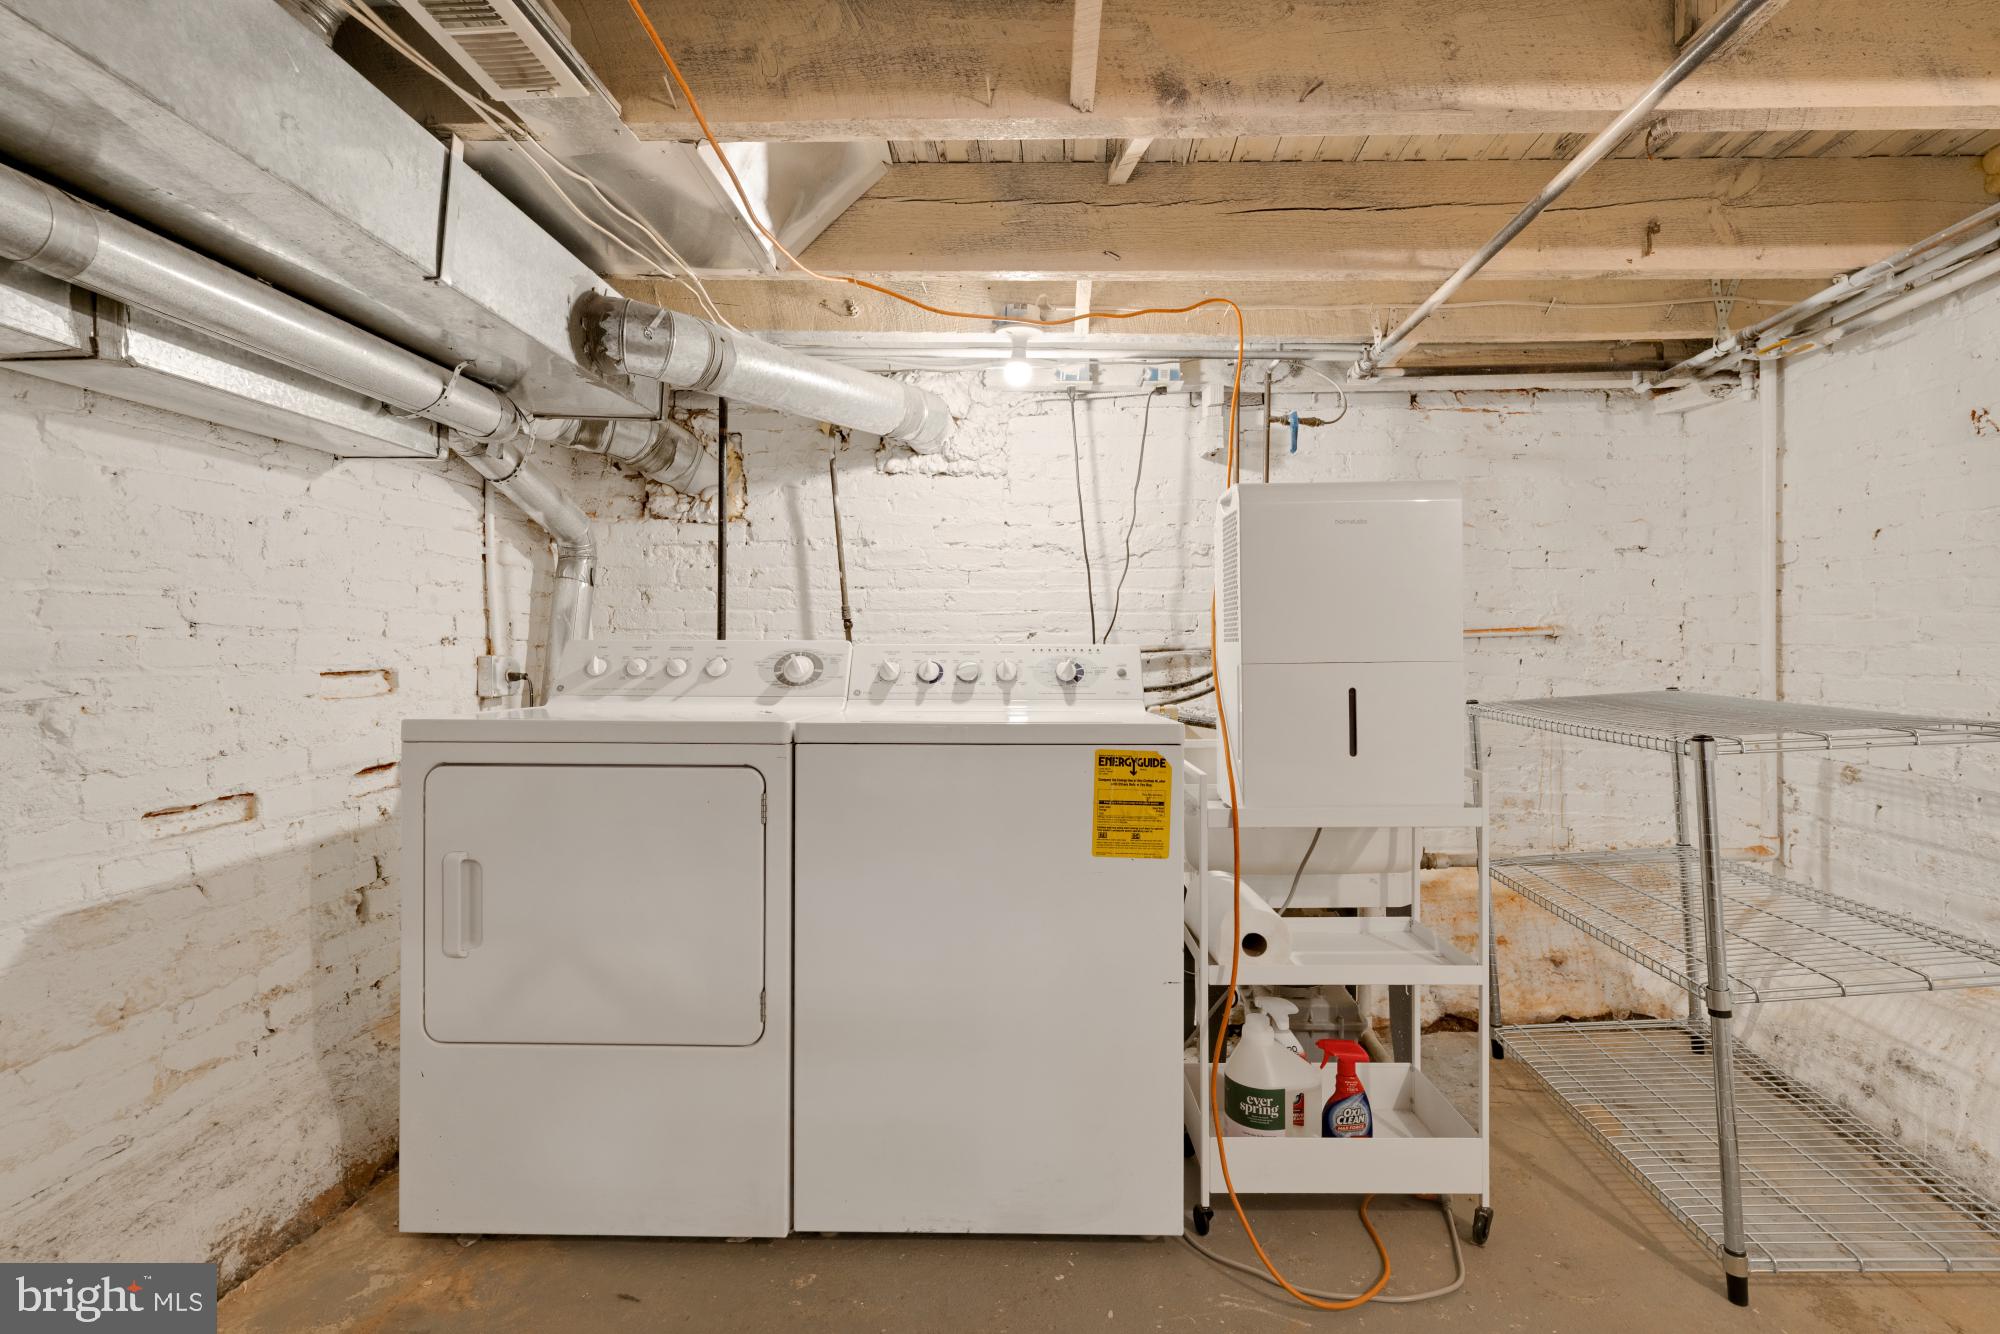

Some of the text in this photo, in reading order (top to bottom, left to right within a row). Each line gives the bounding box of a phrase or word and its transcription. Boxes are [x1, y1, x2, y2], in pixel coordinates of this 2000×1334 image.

[1099, 756, 1166, 768] ENERGYGUIDE
[1246, 1095, 1274, 1107] ever
[1240, 1101, 1279, 1119] spring
[1343, 1108, 1361, 1118] OXI
[1336, 1114, 1365, 1125] CLEAN
